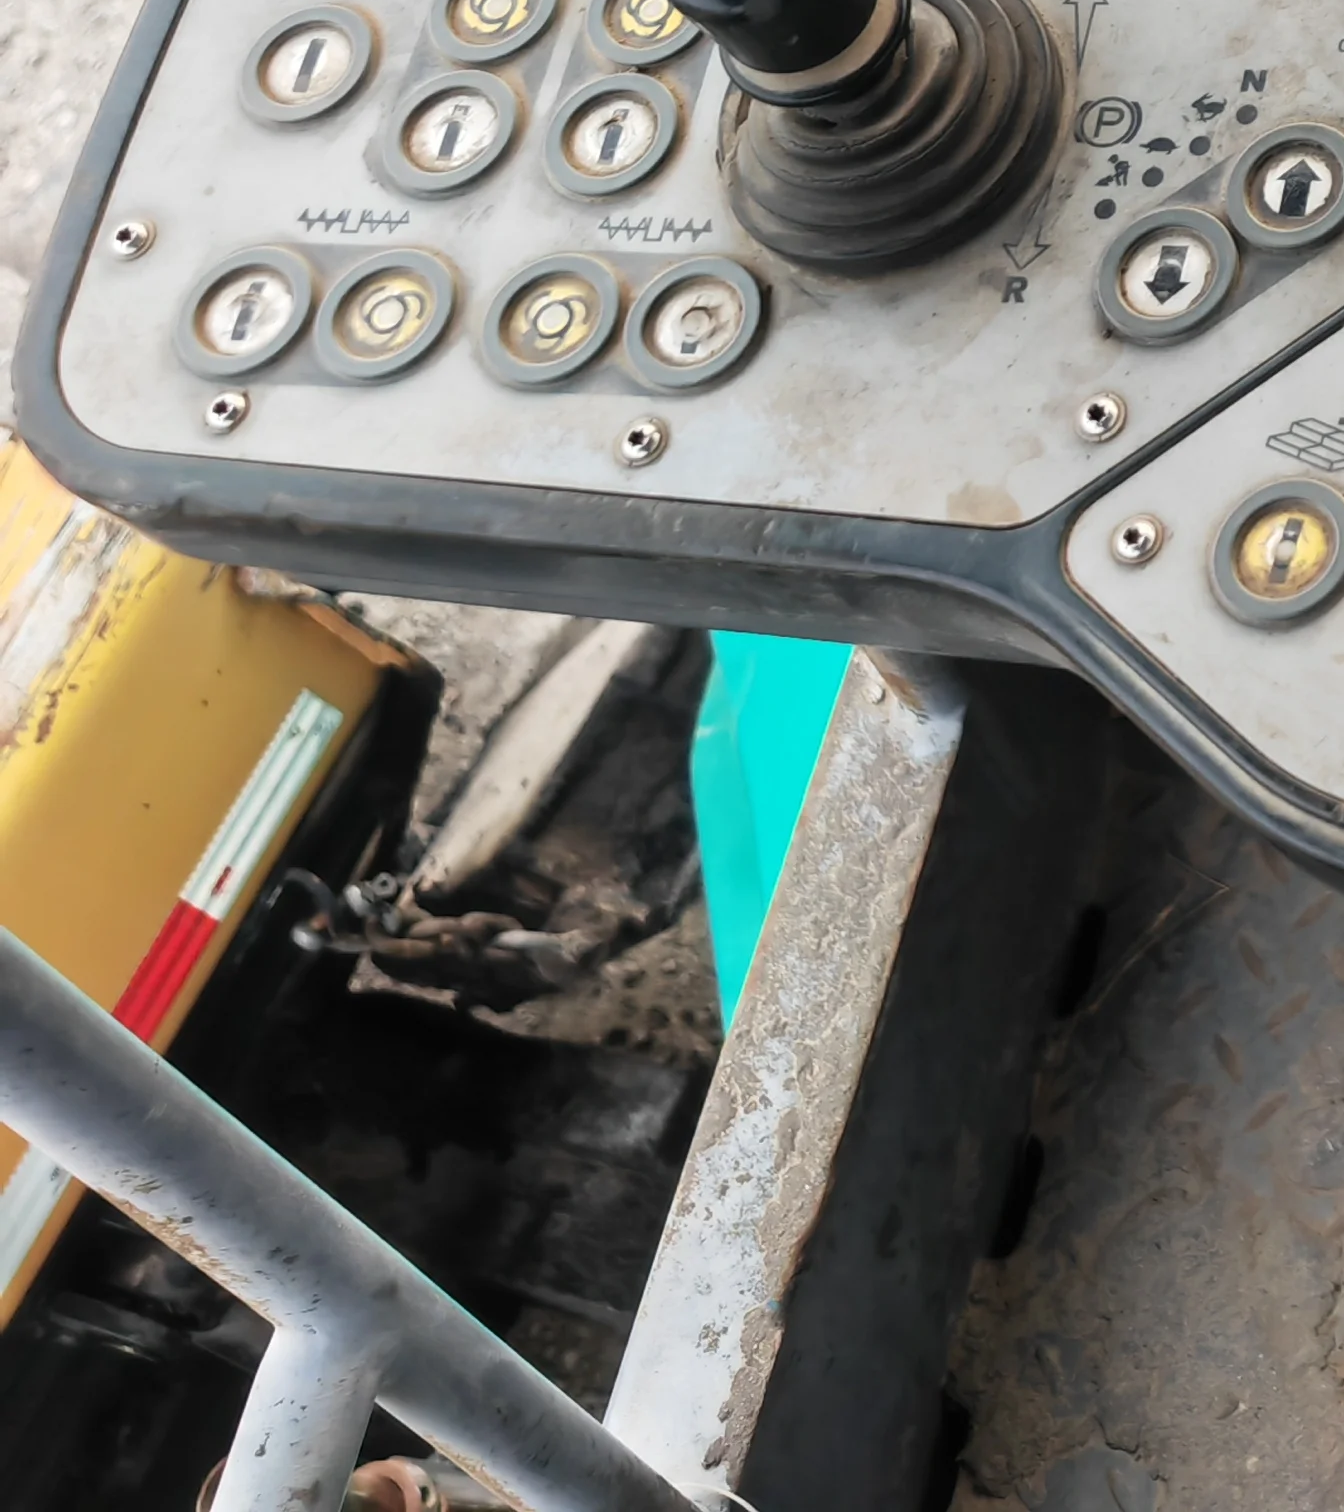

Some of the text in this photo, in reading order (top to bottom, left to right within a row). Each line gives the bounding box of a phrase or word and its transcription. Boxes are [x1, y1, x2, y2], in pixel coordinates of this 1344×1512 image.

[1239, 69, 1269, 93] N
[1093, 106, 1126, 139] P
[1001, 275, 1028, 303] R
